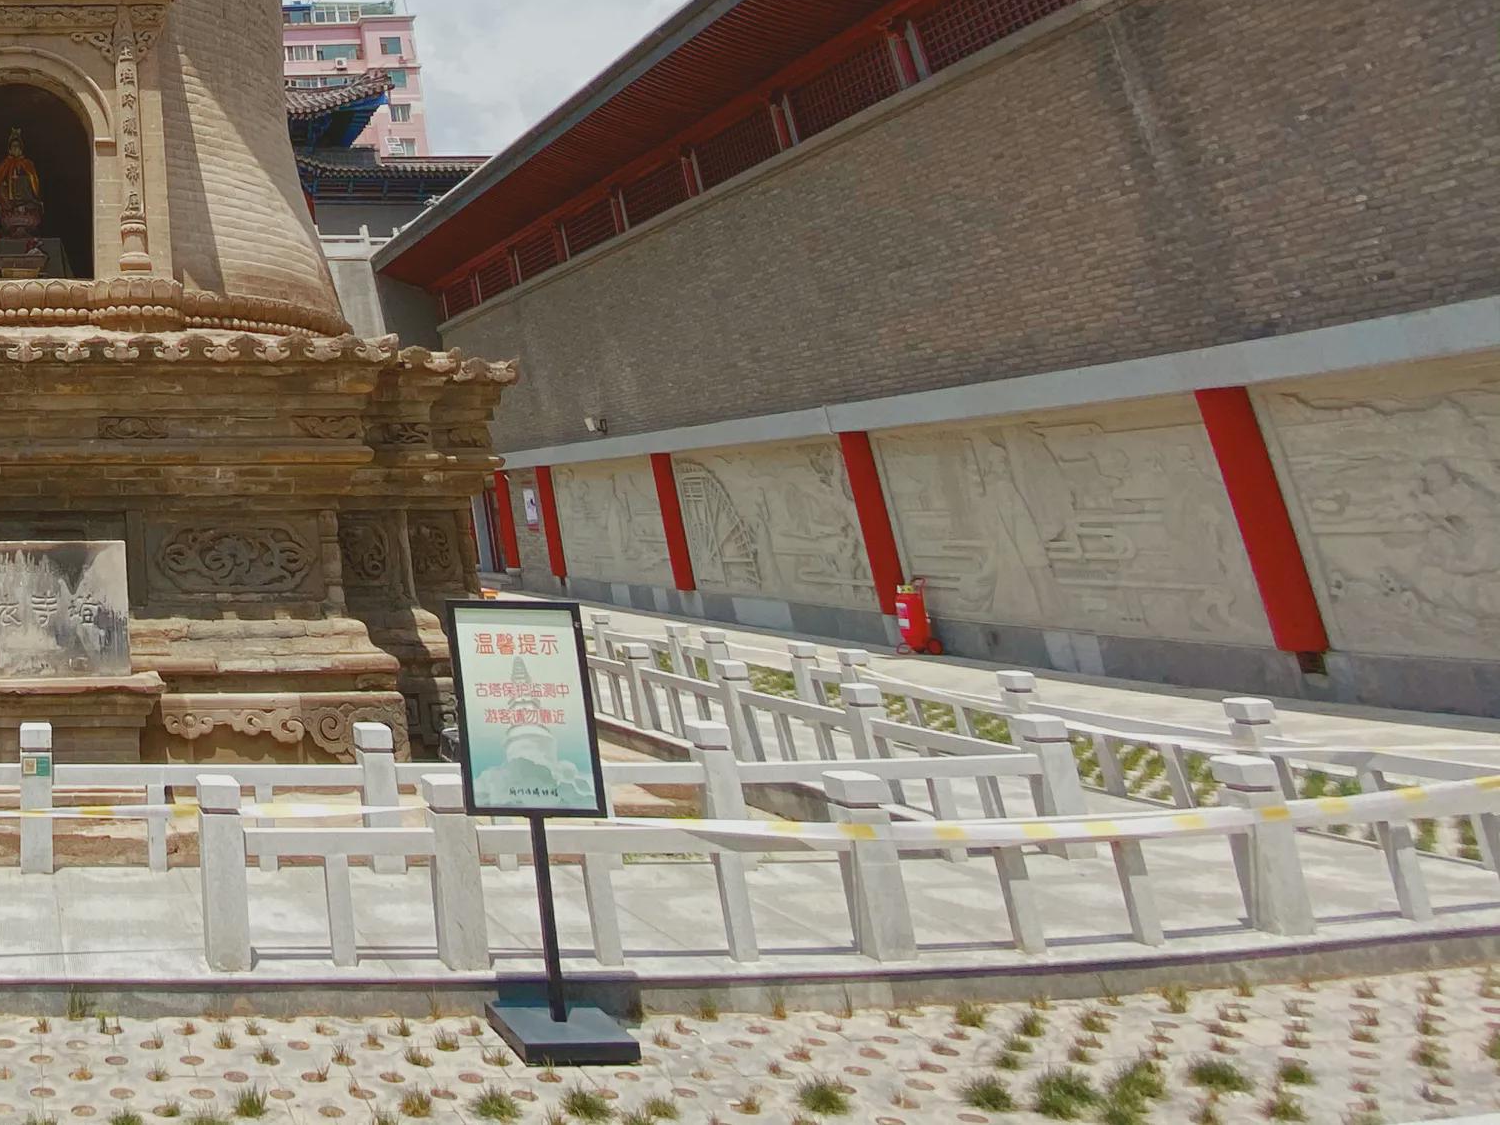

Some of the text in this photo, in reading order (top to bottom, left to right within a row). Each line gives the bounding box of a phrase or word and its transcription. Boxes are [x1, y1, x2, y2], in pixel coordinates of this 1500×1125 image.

[474, 632, 559, 656] 温馨提示
[474, 682, 570, 699] 古塔保护监测中
[484, 708, 566, 725] 游客请勿靠近
